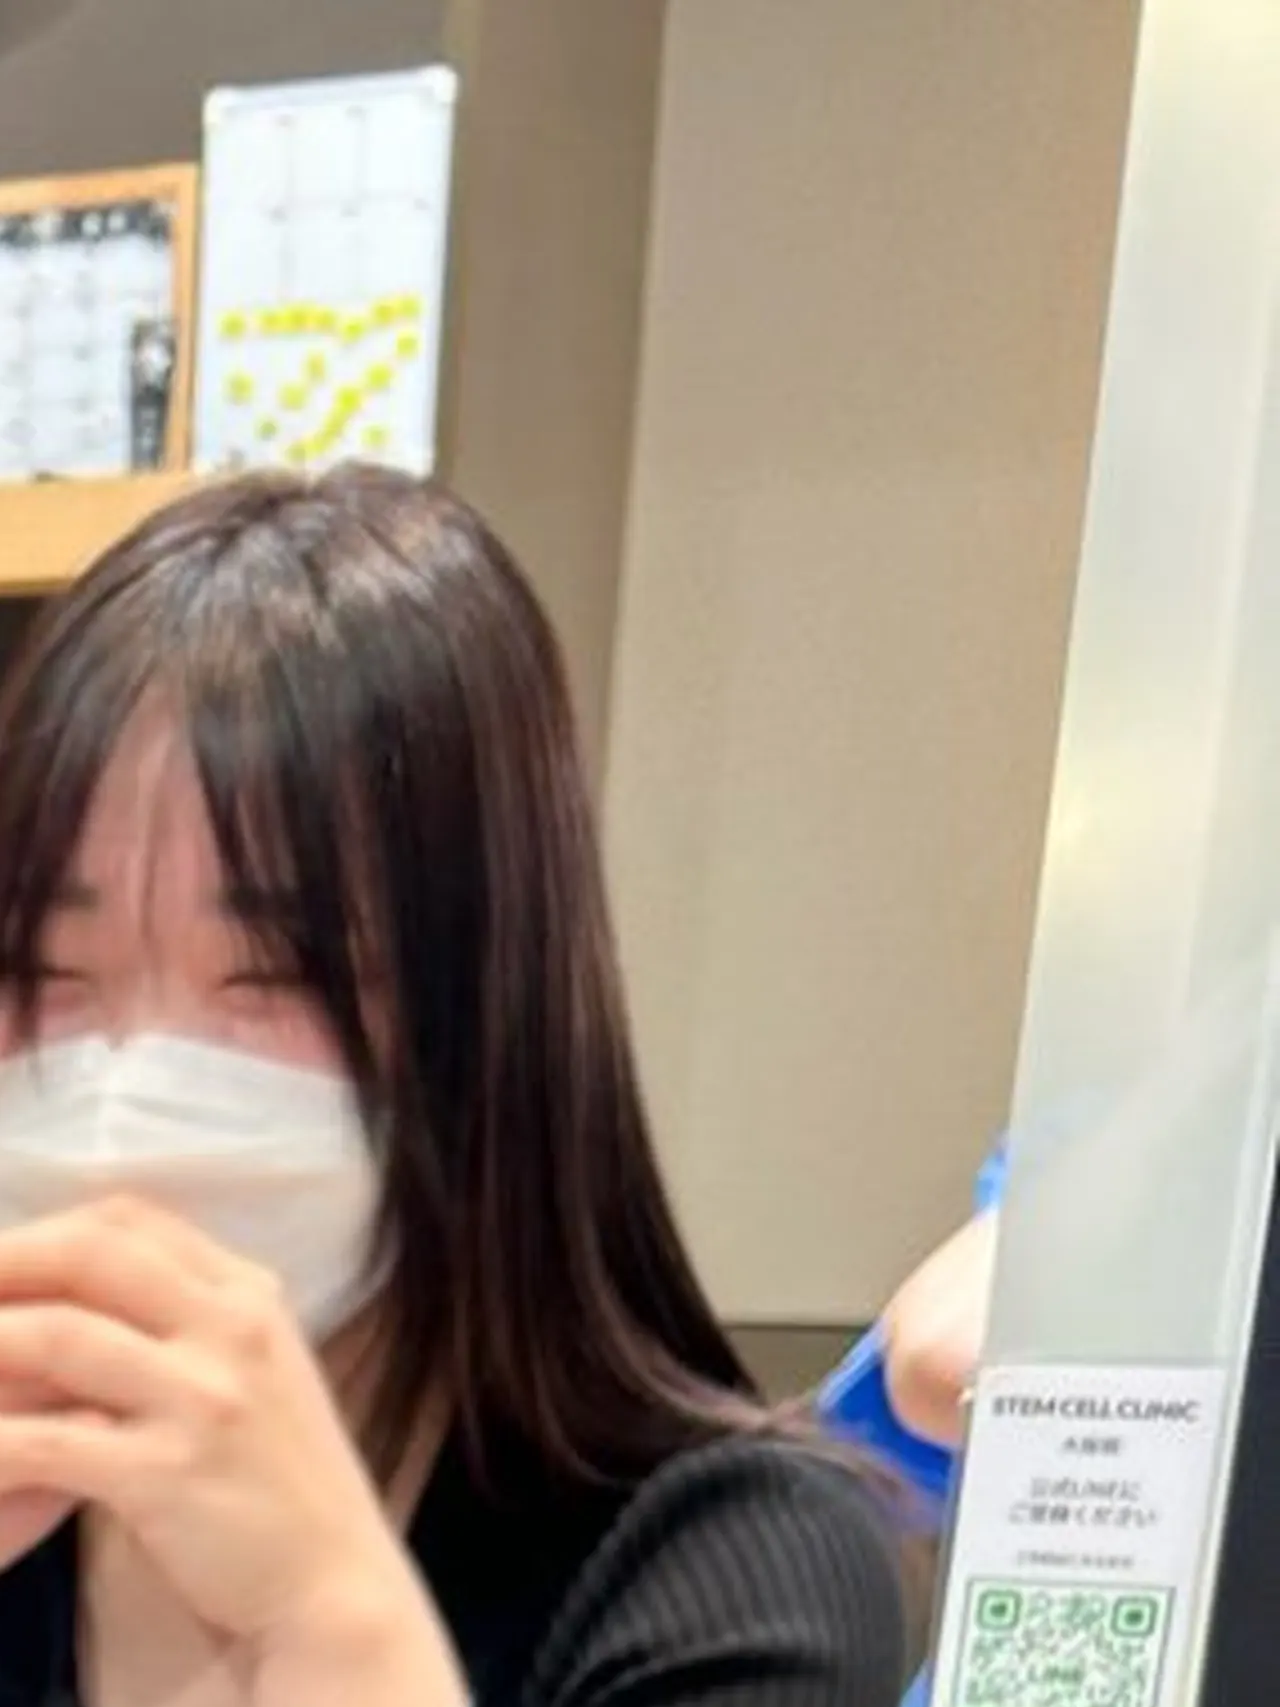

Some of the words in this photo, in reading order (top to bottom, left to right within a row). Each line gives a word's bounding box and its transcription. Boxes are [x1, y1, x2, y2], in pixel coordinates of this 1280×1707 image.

[992, 1396, 1056, 1417] STEM
[1060, 1397, 1111, 1420] CELL
[1117, 1398, 1202, 1423] CLINIC
